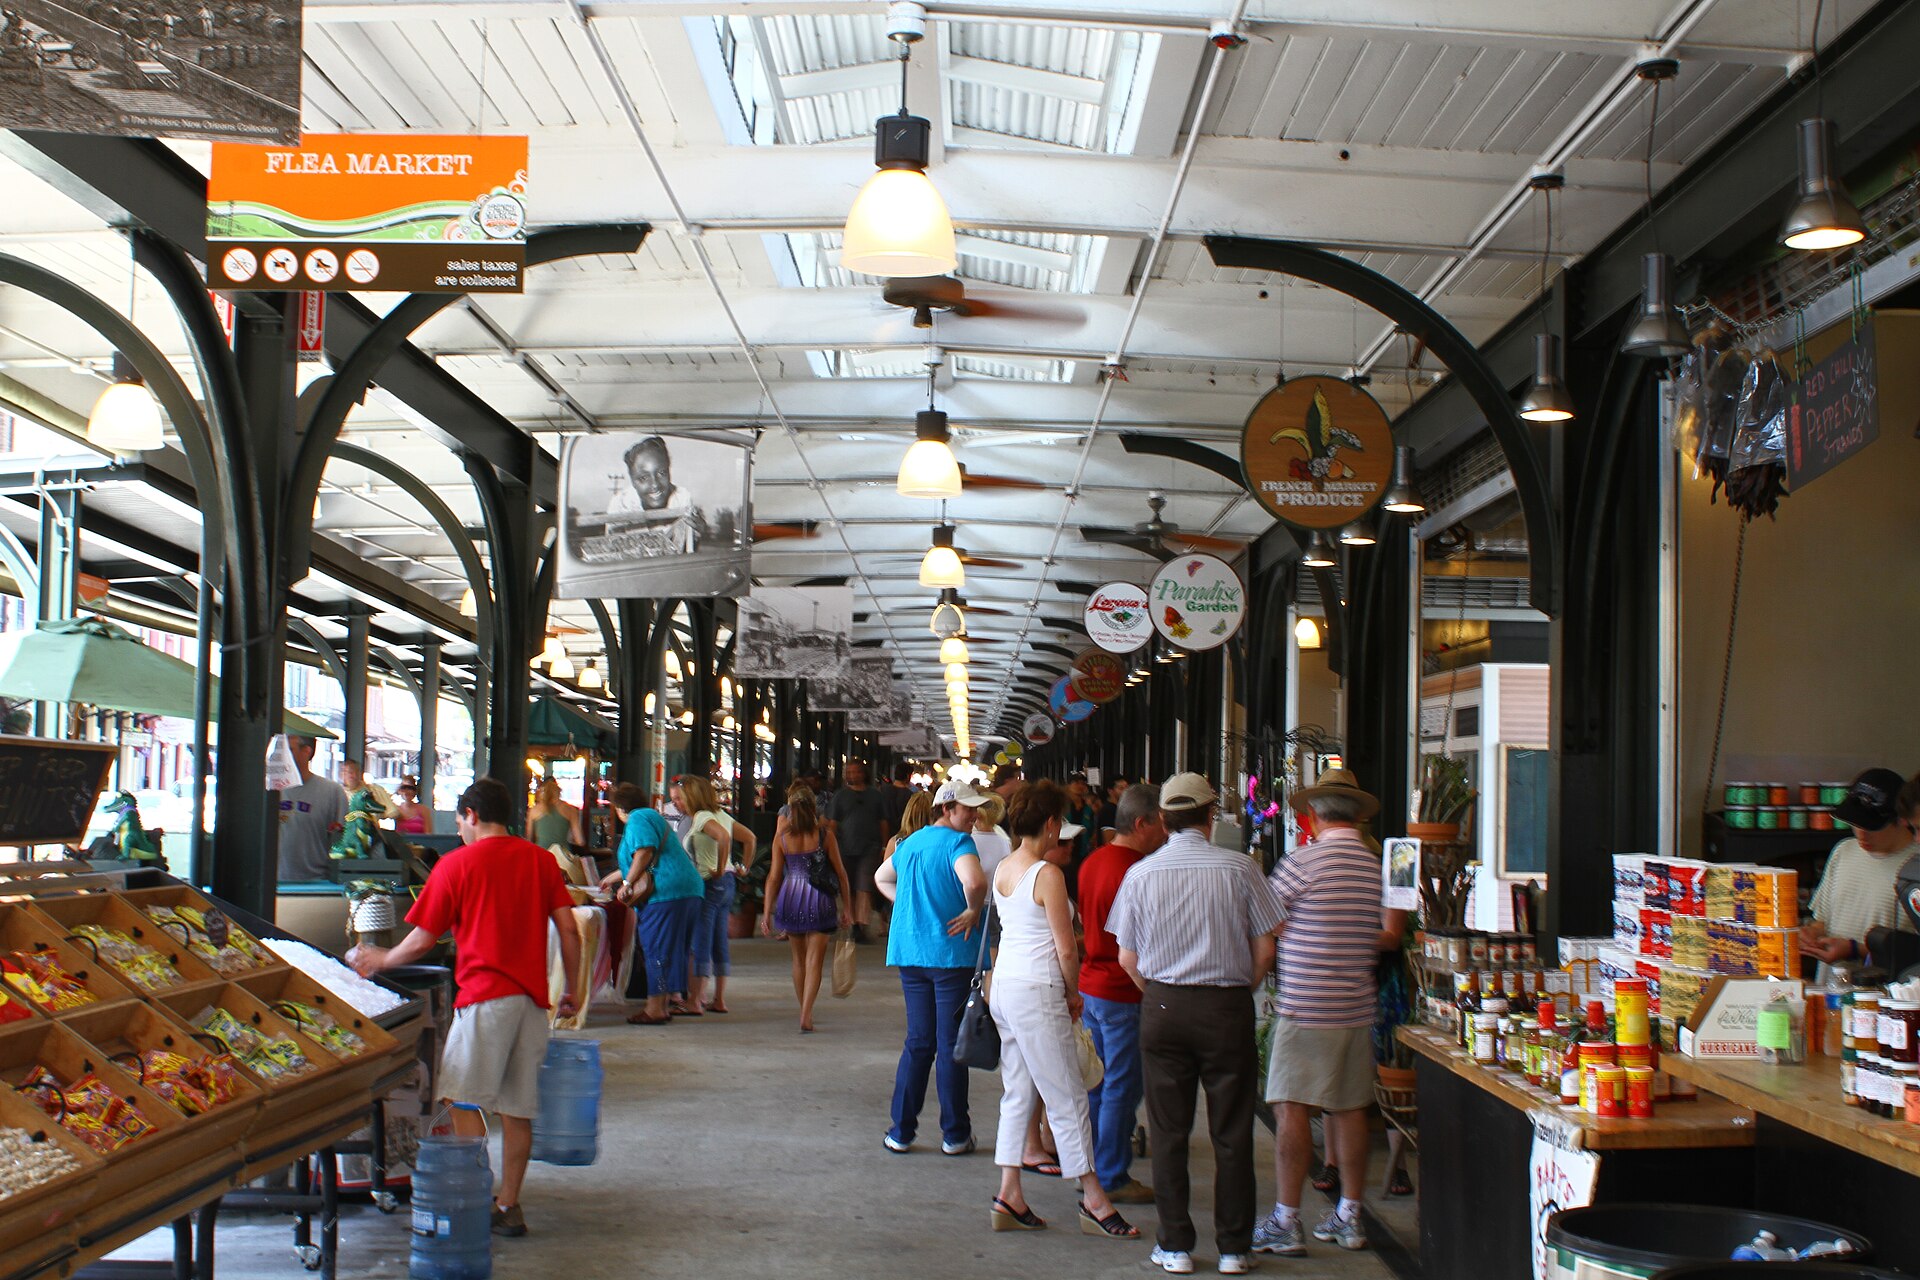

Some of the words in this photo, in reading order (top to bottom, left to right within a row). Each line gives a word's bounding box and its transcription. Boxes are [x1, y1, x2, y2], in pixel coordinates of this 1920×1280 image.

[130, 115, 147, 125] The
[148, 117, 180, 128] Historic
[182, 119, 201, 129] New
[202, 120, 236, 131] Orleans
[237, 122, 279, 134] Collection
[264, 152, 341, 175] FLEA
[346, 153, 473, 176] MARKET
[447, 259, 480, 271] sales
[482, 260, 518, 271] taxes
[434, 276, 458, 286] are
[459, 275, 517, 287] collected
[1806, 371, 1826, 398] RED
[1806, 394, 1852, 450] PEPPER
[1261, 480, 1313, 492] FRENCH
[1323, 481, 1377, 492] MARKET
[1276, 492, 1364, 507] PRODUCE
[1154, 578, 1240, 601] Paradise
[1185, 600, 1239, 613] Garden
